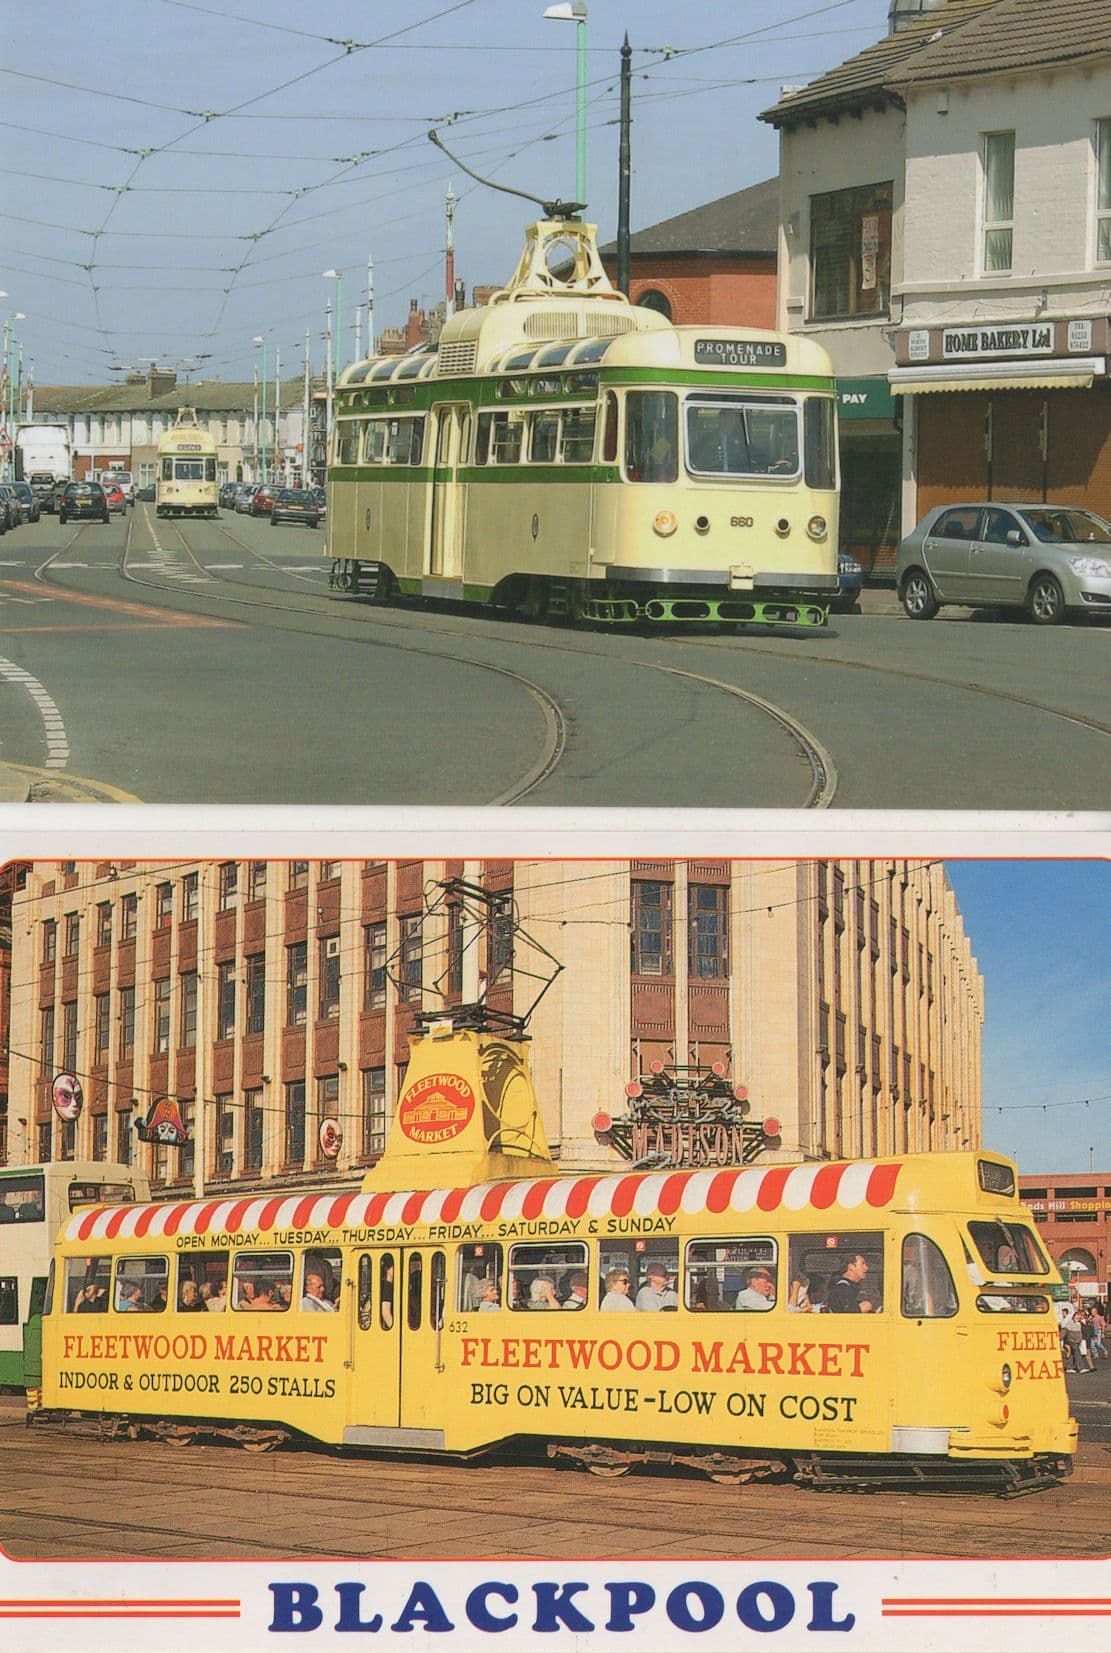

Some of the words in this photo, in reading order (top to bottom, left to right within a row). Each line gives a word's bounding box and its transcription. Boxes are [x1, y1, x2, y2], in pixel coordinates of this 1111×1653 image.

[697, 342, 781, 357] PROMENADE
[945, 333, 978, 352] HOME
[981, 329, 1028, 351] BAKERY
[1032, 327, 1050, 347] Ltd
[721, 353, 757, 364] TOUR
[842, 393, 867, 404] PAY
[730, 516, 753, 528] 660
[405, 1075, 471, 1104] FLEETWOOD
[409, 1123, 458, 1142] MARKET
[1048, 1201, 1066, 1210] Hill
[176, 1235, 206, 1248] OPEN
[498, 1220, 581, 1237] SATURDAY
[588, 1219, 598, 1233] &
[607, 1216, 676, 1232] SUNDAY
[449, 1321, 468, 1333] 632
[63, 1334, 207, 1360] FLEETWOOD
[214, 1335, 328, 1363] MARKET
[461, 1338, 681, 1371] FLEETWOOD
[691, 1341, 870, 1377] MARKET
[59, 1371, 119, 1390] INDOOR
[123, 1374, 133, 1391] &
[139, 1373, 220, 1393] OUTDOOR
[229, 1376, 263, 1394] 250
[267, 1377, 336, 1398] STALLS
[470, 1383, 509, 1405] BIG
[517, 1384, 551, 1407] ON
[727, 1392, 767, 1417] ON
[780, 1394, 857, 1422] COST
